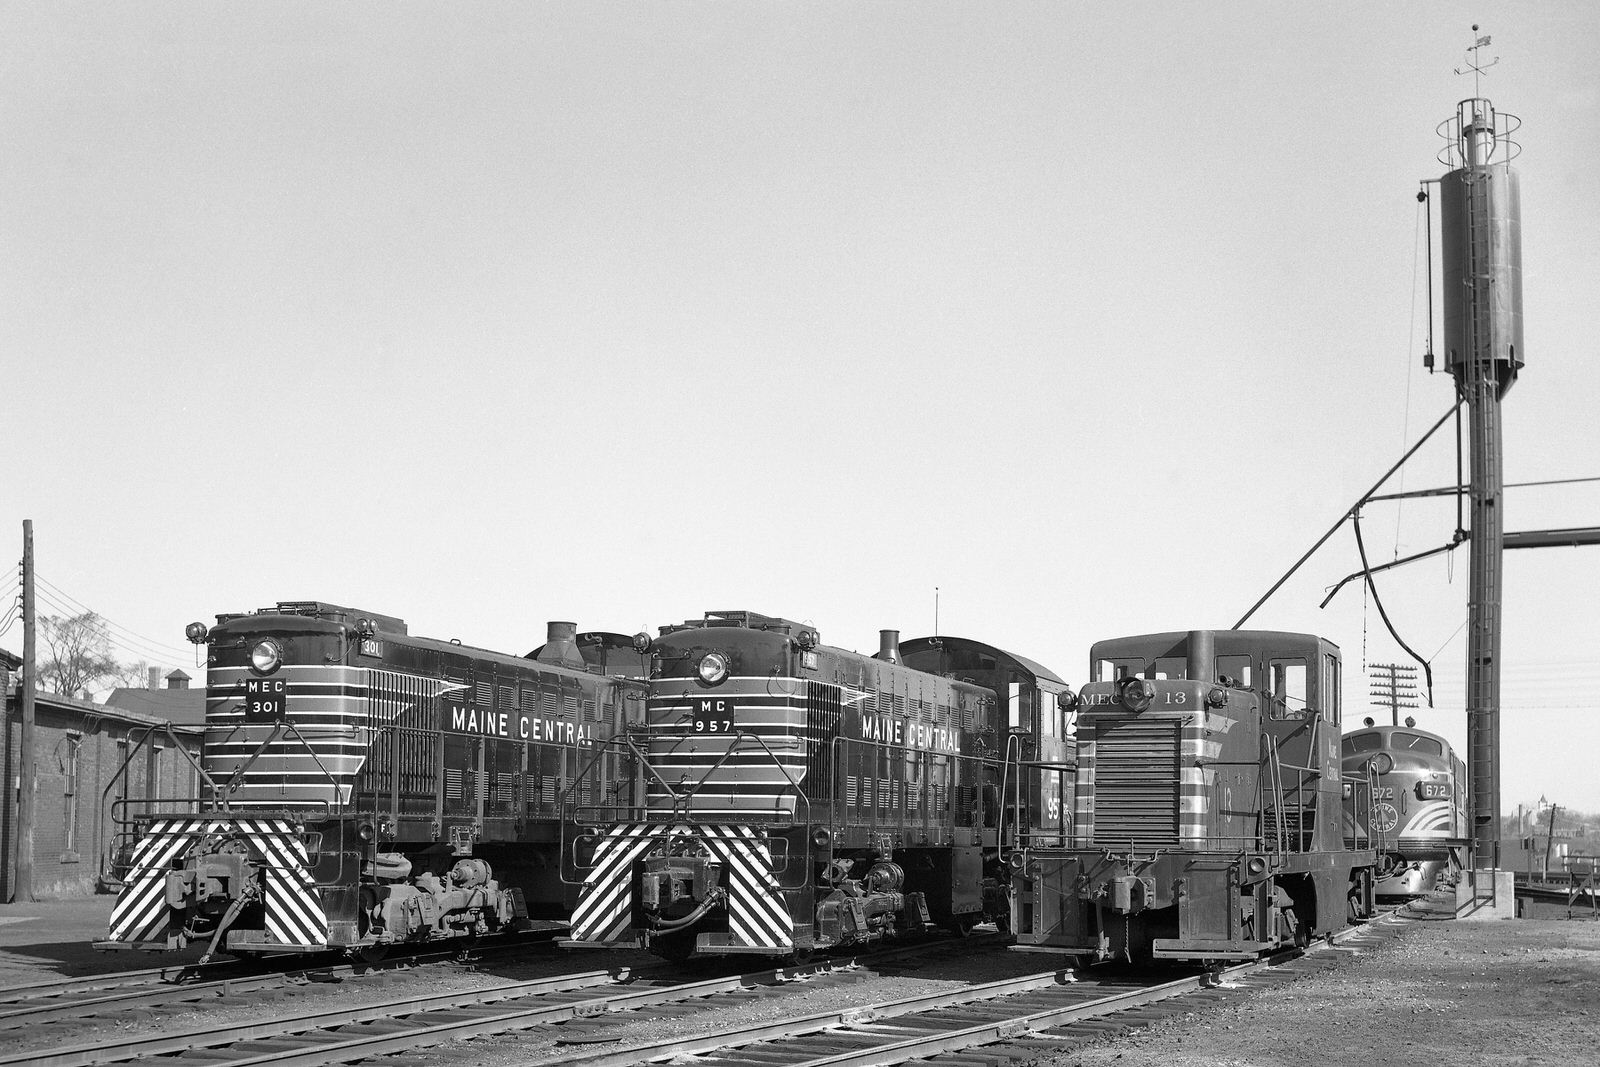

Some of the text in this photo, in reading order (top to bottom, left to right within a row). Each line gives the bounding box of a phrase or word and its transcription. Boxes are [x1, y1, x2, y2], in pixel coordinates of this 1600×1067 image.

[364, 640, 379, 655] 301
[249, 681, 283, 693] MEC
[1164, 691, 1186, 705] 13
[252, 701, 278, 713] 301
[452, 706, 592, 746] MAINE CENTRAL
[695, 720, 731, 732] 957
[862, 715, 961, 752] MAINE CENTRAL
[1372, 787, 1393, 799] 672
[1426, 784, 1447, 797] 672
[1048, 797, 1060, 820] 95
[381, 823, 386, 833] F
